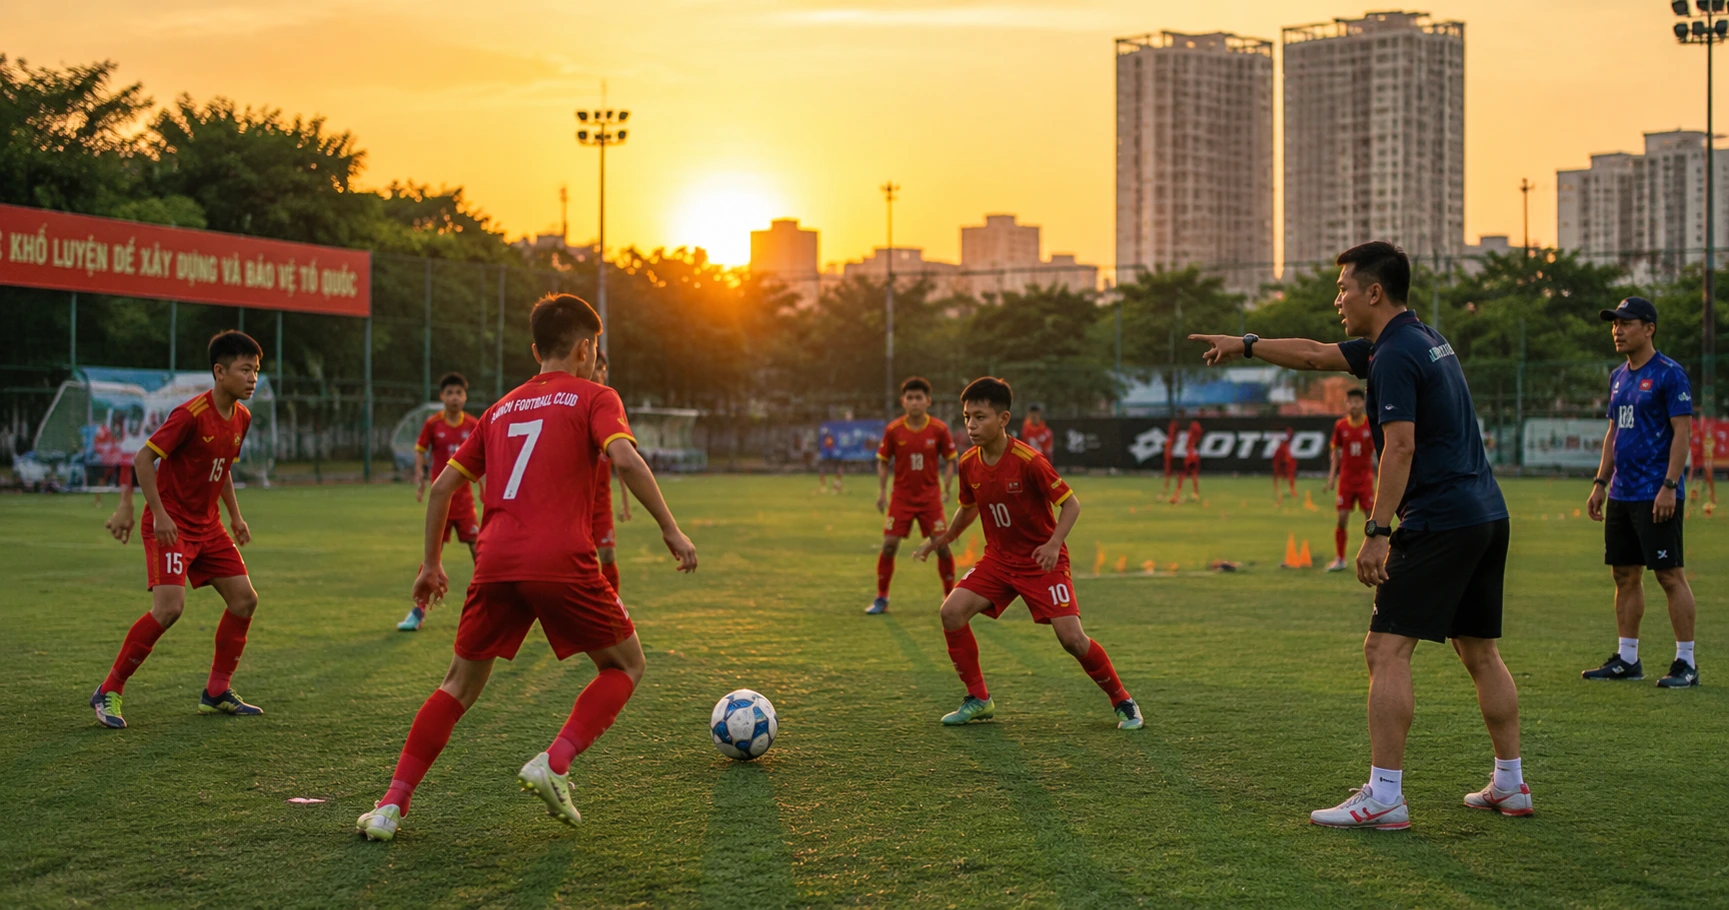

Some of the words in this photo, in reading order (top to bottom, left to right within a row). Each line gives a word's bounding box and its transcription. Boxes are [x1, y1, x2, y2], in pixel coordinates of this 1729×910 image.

[1171, 430, 1326, 459] LOTTO
[209, 457, 226, 482] 15
[503, 419, 543, 499] 7
[989, 503, 1011, 528] 10
[165, 552, 183, 575] 15
[1048, 583, 1071, 605] 10
